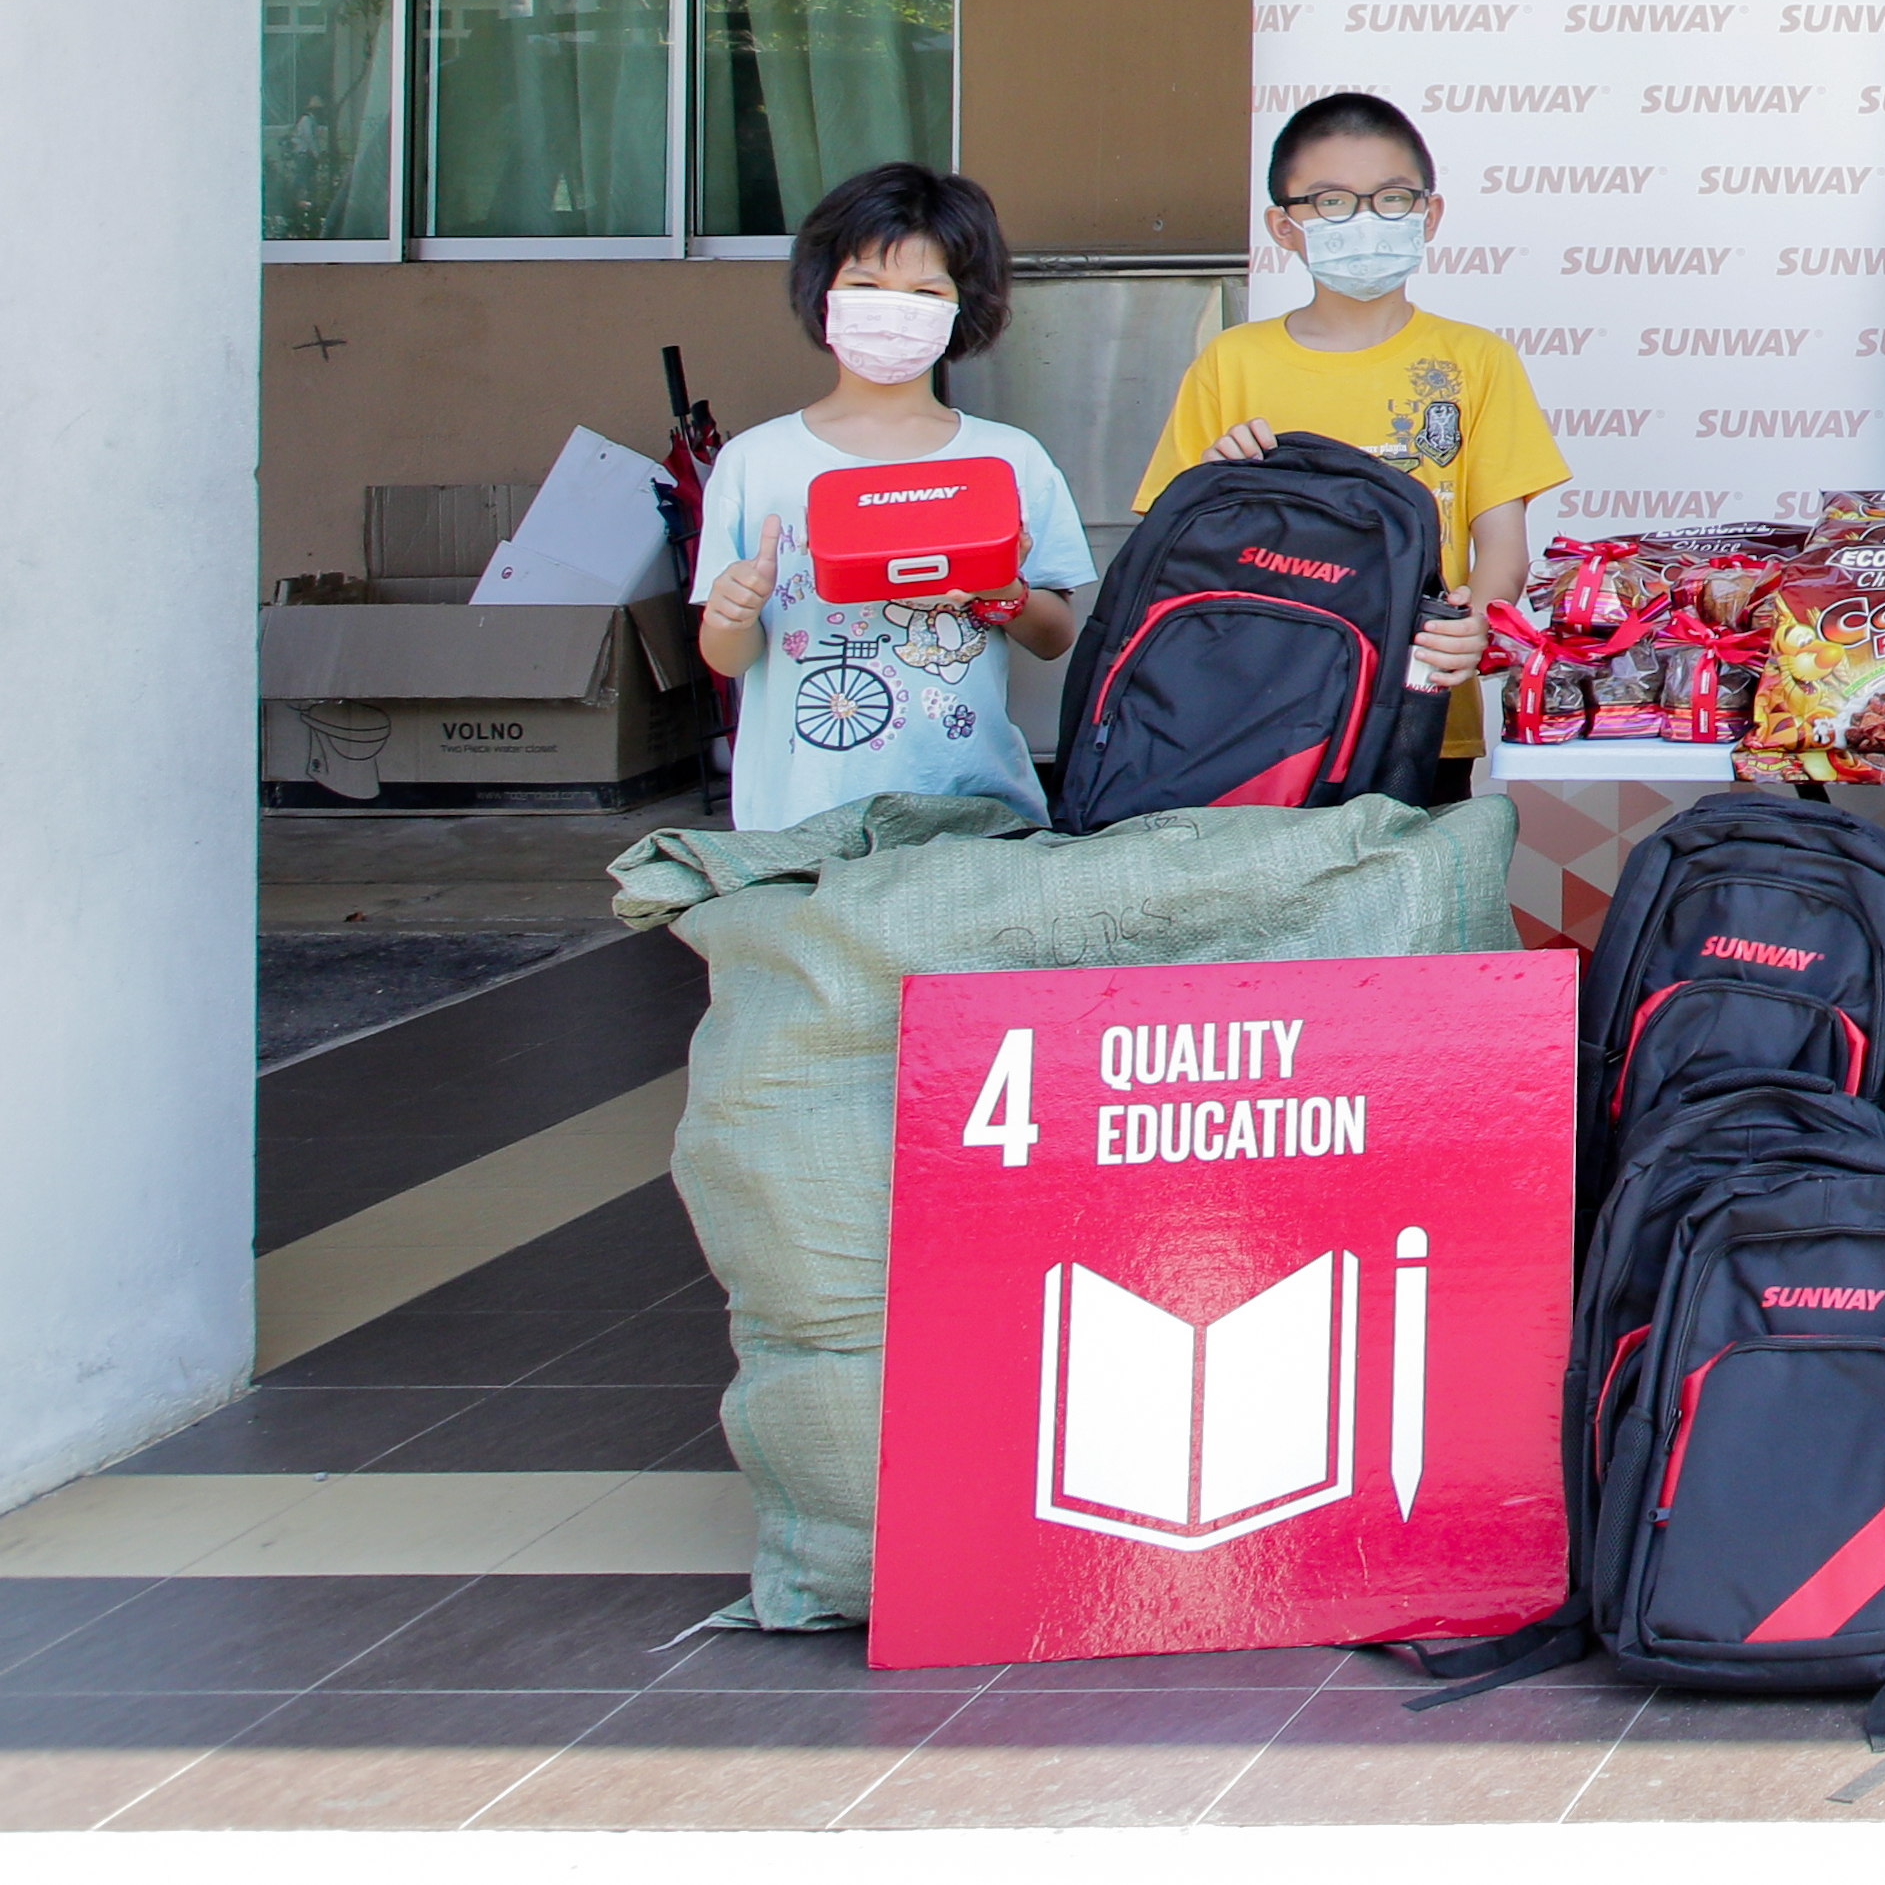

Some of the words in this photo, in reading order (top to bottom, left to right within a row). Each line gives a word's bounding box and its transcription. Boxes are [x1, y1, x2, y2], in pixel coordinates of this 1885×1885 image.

[1344, 4, 1519, 33] SUNWAY
[1564, 4, 1736, 33] SUNWAY
[1422, 85, 1597, 114] SUNWAY
[1641, 85, 1812, 114] SUNWAY
[1480, 166, 1654, 195] SUNWAY
[1698, 166, 1873, 195] SUNWAY
[1418, 247, 1514, 276] WAY
[1561, 247, 1731, 276] SUNWAY
[1494, 328, 1593, 357] WAY
[1638, 328, 1810, 357] SUNWAY
[1696, 409, 1870, 438] SUNWAY
[858, 485, 960, 507] SUNWAY
[1558, 490, 1730, 519] SUNWAY
[1237, 546, 1350, 584] SUNWAY
[442, 722, 524, 741] VOLNO
[1700, 934, 1817, 972] SUNWAY
[1100, 1018, 1304, 1092] QUALITY
[962, 1028, 1040, 1168] 4
[1096, 1095, 1367, 1166] EDUCATION
